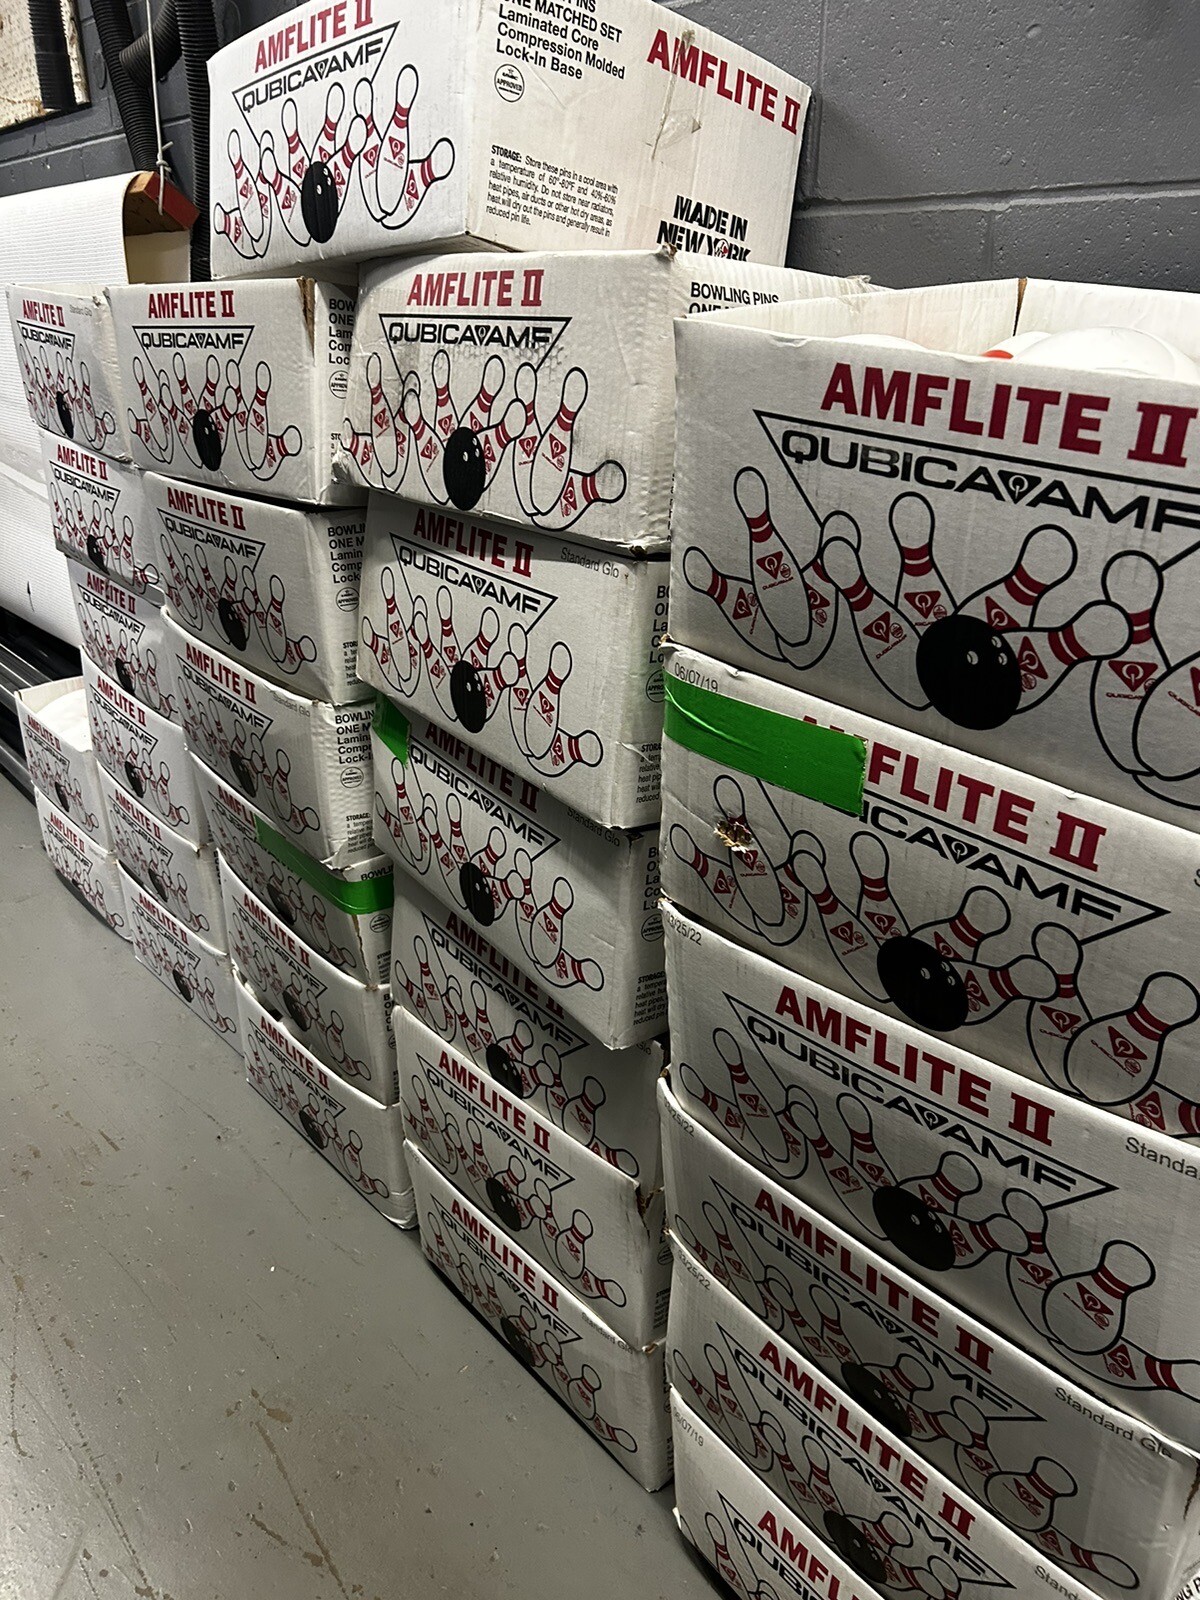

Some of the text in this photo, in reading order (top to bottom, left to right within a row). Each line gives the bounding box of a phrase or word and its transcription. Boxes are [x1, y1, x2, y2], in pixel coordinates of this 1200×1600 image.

[254, 5, 347, 73] AMFLITE
[499, 3, 599, 51] Laminated Core
[534, 0, 623, 43] MATCHED SET
[496, 38, 603, 79] Lock-In Base
[497, 22, 625, 80] Compression Molded
[646, 29, 778, 122] AMFLITE
[656, 220, 705, 253] NEW
[673, 195, 749, 241] MADE IN
[148, 290, 216, 319] AMFLITE
[407, 270, 514, 306] AMFLITE
[690, 281, 751, 305] BOWLING
[22, 299, 56, 326] AMFLITE
[329, 313, 354, 327] ONE
[820, 362, 1199, 468] AMFLITE II
[57, 444, 97, 477] AMFLITE
[167, 487, 229, 526] AMFLITE
[329, 537, 354, 549] ONE
[413, 509, 507, 568] AMFLITE
[561, 547, 619, 578] Standard Glo
[186, 642, 241, 695] AMFLITE
[674, 661, 718, 693] 06/07/19
[97, 675, 136, 720] AMFLITE
[335, 710, 374, 724] BOWLIN
[336, 724, 360, 735] ONE
[425, 724, 516, 799] AMFLITE
[1049, 811, 1107, 872] II
[243, 894, 296, 956] AMFLITE
[260, 1016, 314, 1078] AMFLITE
[775, 985, 991, 1118] AMFLITE
[1008, 1091, 1055, 1147] II
[438, 1050, 527, 1135] AMFLITE
[1125, 1136, 1200, 1180] Standa
[451, 1198, 536, 1292] AMFLITE
[754, 1188, 940, 1338] AMFLITE
[955, 1325, 994, 1375] II
[1055, 1387, 1133, 1441] Standard
[758, 1340, 976, 1541] AMFLITE II
[757, 1510, 860, 1600] AMFL
